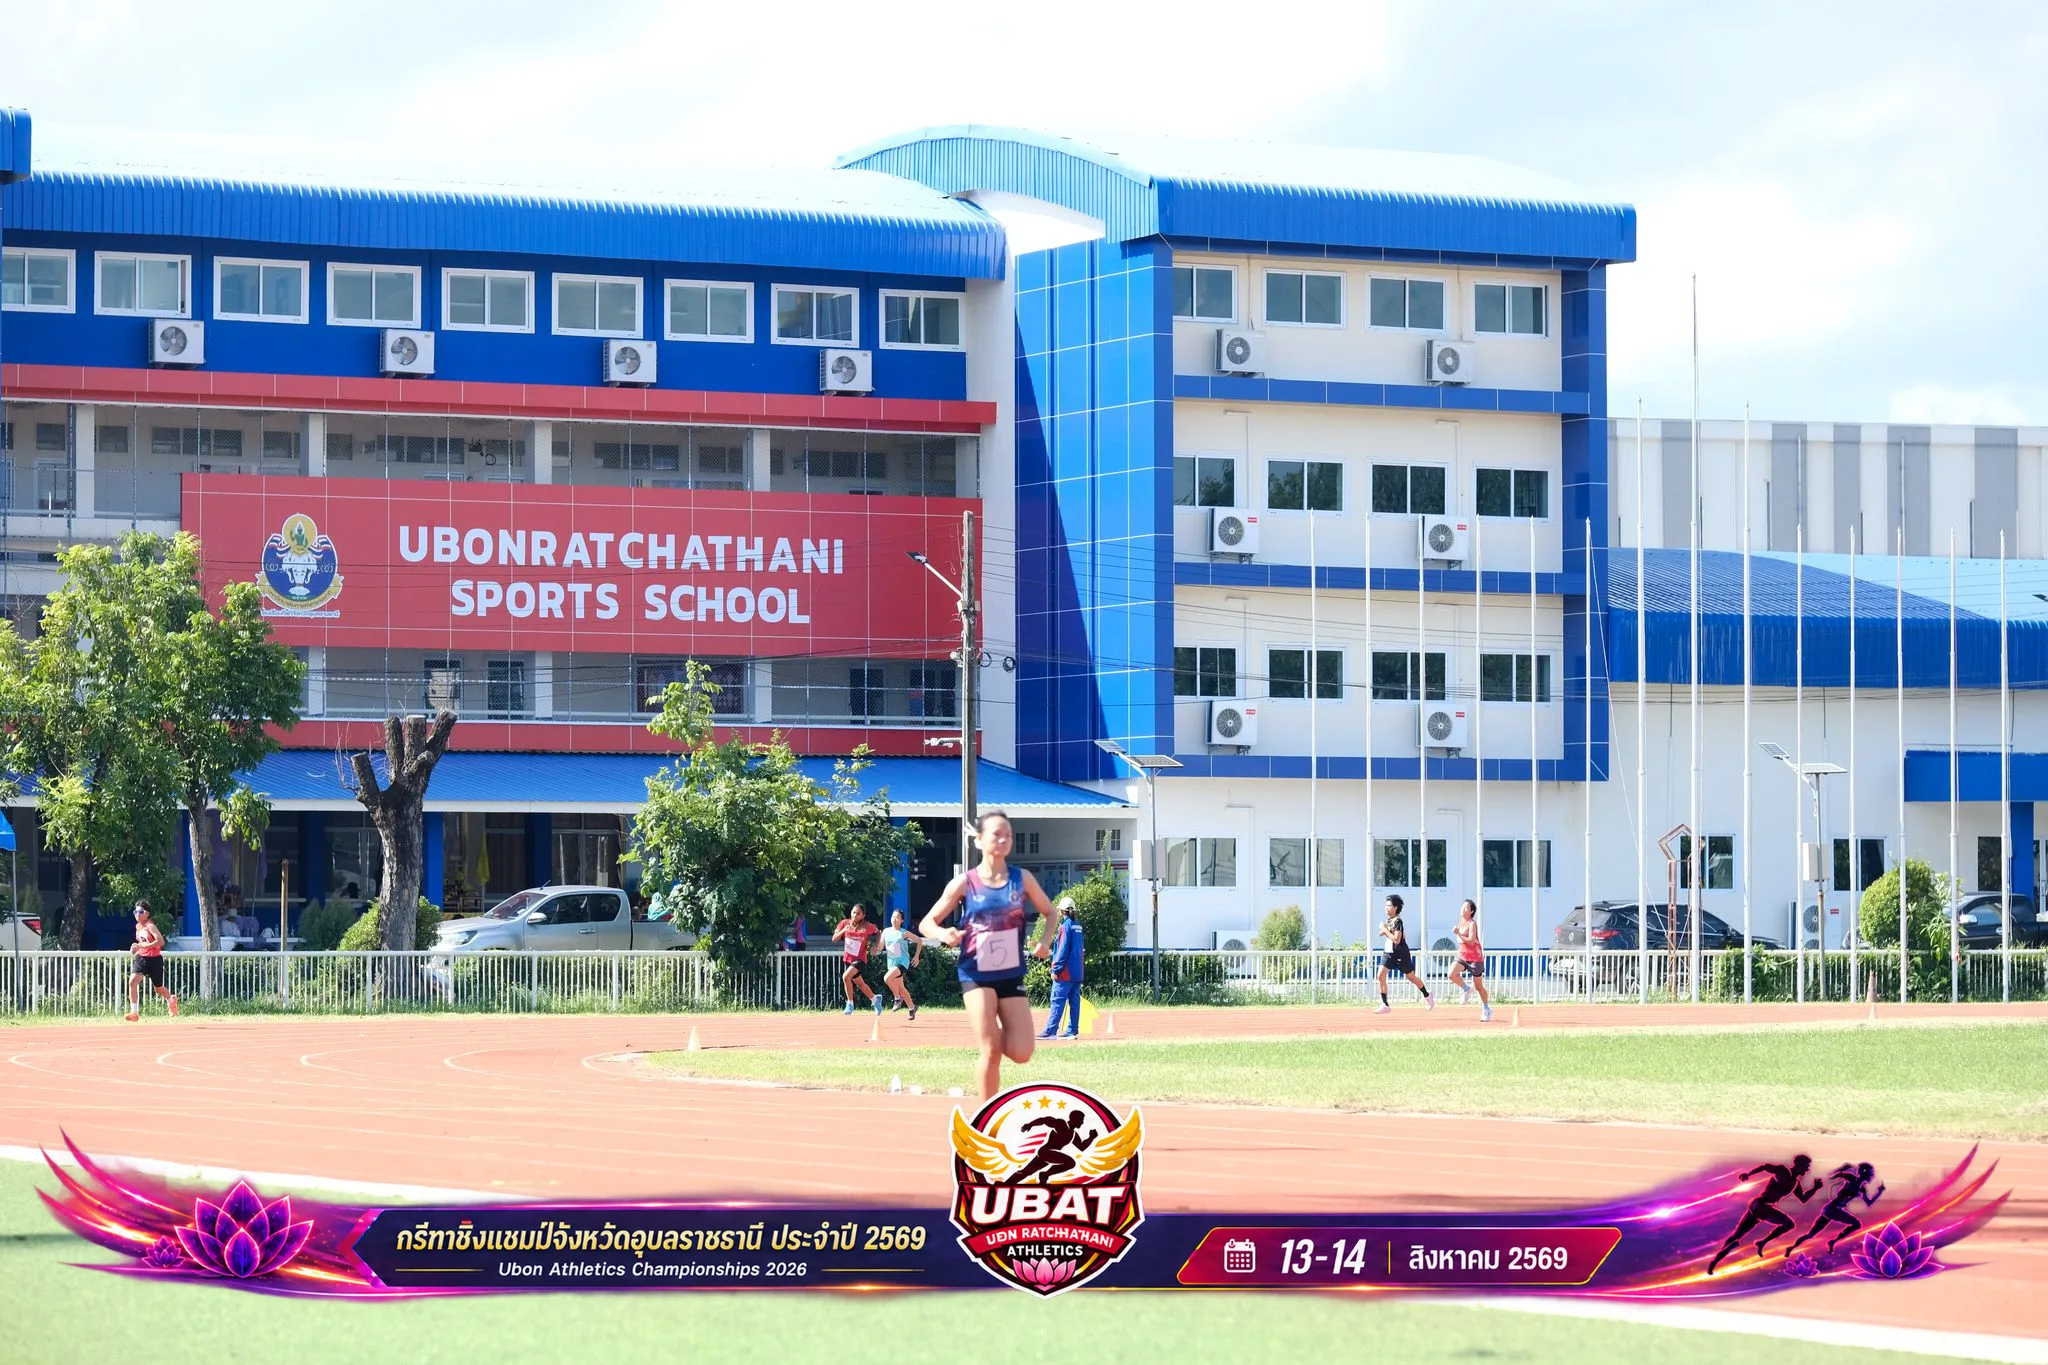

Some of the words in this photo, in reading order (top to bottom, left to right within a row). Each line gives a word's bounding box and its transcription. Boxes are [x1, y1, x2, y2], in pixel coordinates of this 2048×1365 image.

[398, 525, 845, 575] UBONRATCHATHANI
[450, 579, 620, 620] SPORTS
[644, 584, 810, 625] SCHOOL
[989, 939, 1008, 968] 5
